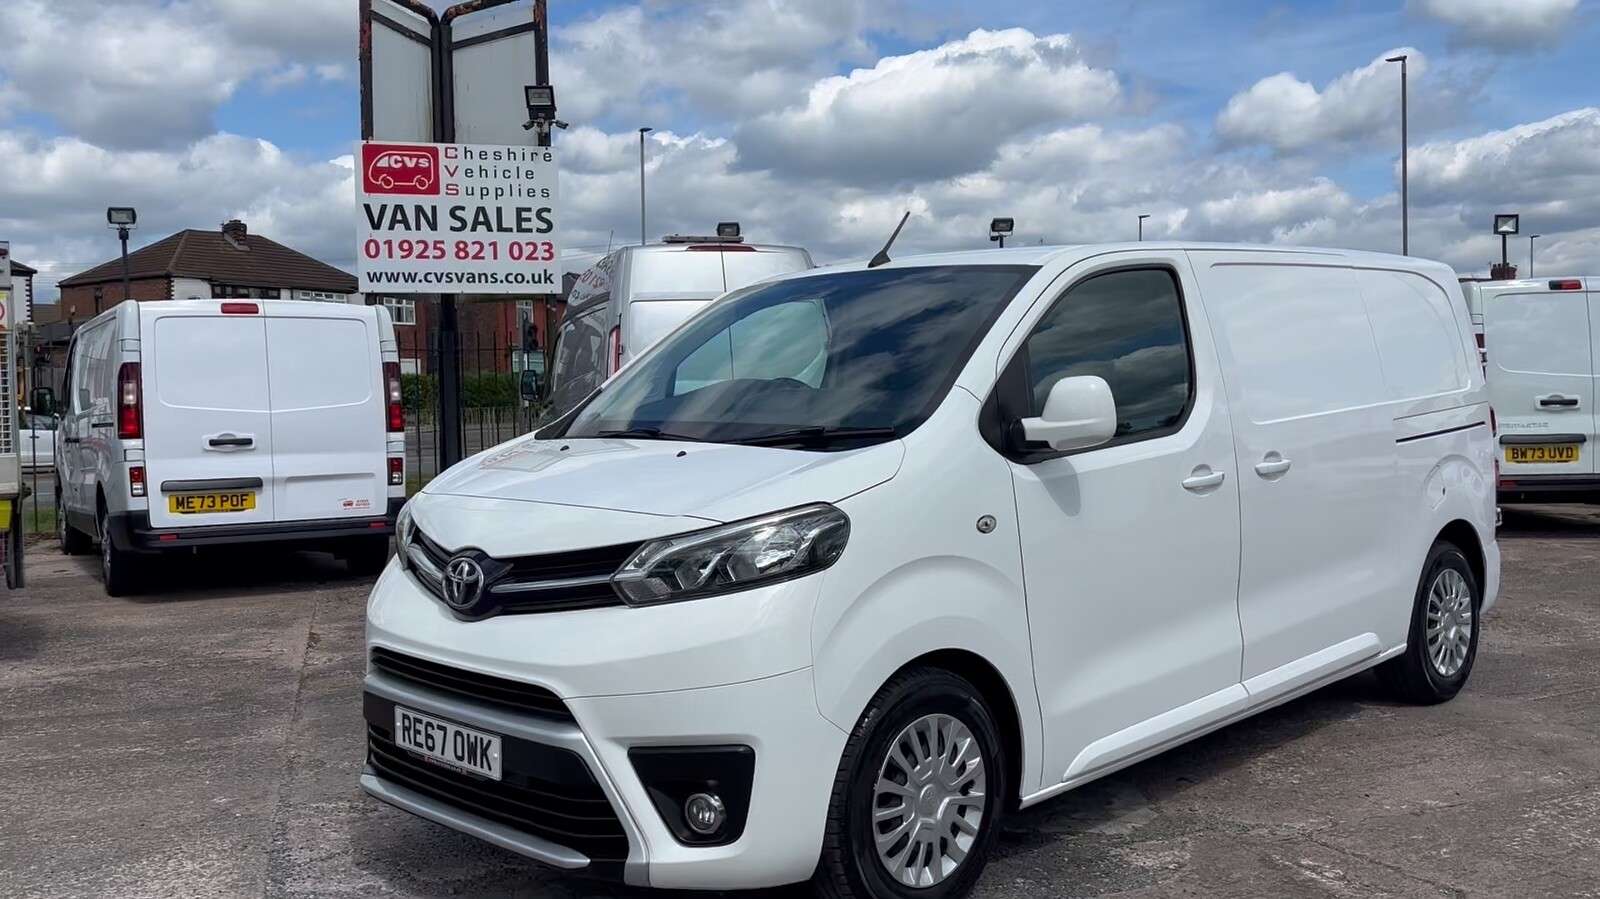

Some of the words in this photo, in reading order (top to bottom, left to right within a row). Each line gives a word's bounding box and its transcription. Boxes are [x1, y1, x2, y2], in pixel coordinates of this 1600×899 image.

[444, 146, 552, 162] Cheshire
[444, 165, 534, 179] Vehicle
[445, 183, 550, 200] Supplies
[363, 203, 438, 231] VAN
[449, 205, 554, 234] SALES
[364, 239, 446, 260] 01925
[454, 240, 498, 260] 821
[508, 241, 554, 261] 023
[366, 269, 554, 284] www.cvsvans.co.uk
[1511, 447, 1545, 459] BW73
[1548, 446, 1574, 459] UVD
[175, 495, 216, 510] ME73
[220, 494, 249, 508] POF
[402, 712, 447, 756] RE67
[453, 729, 493, 772] OWK
